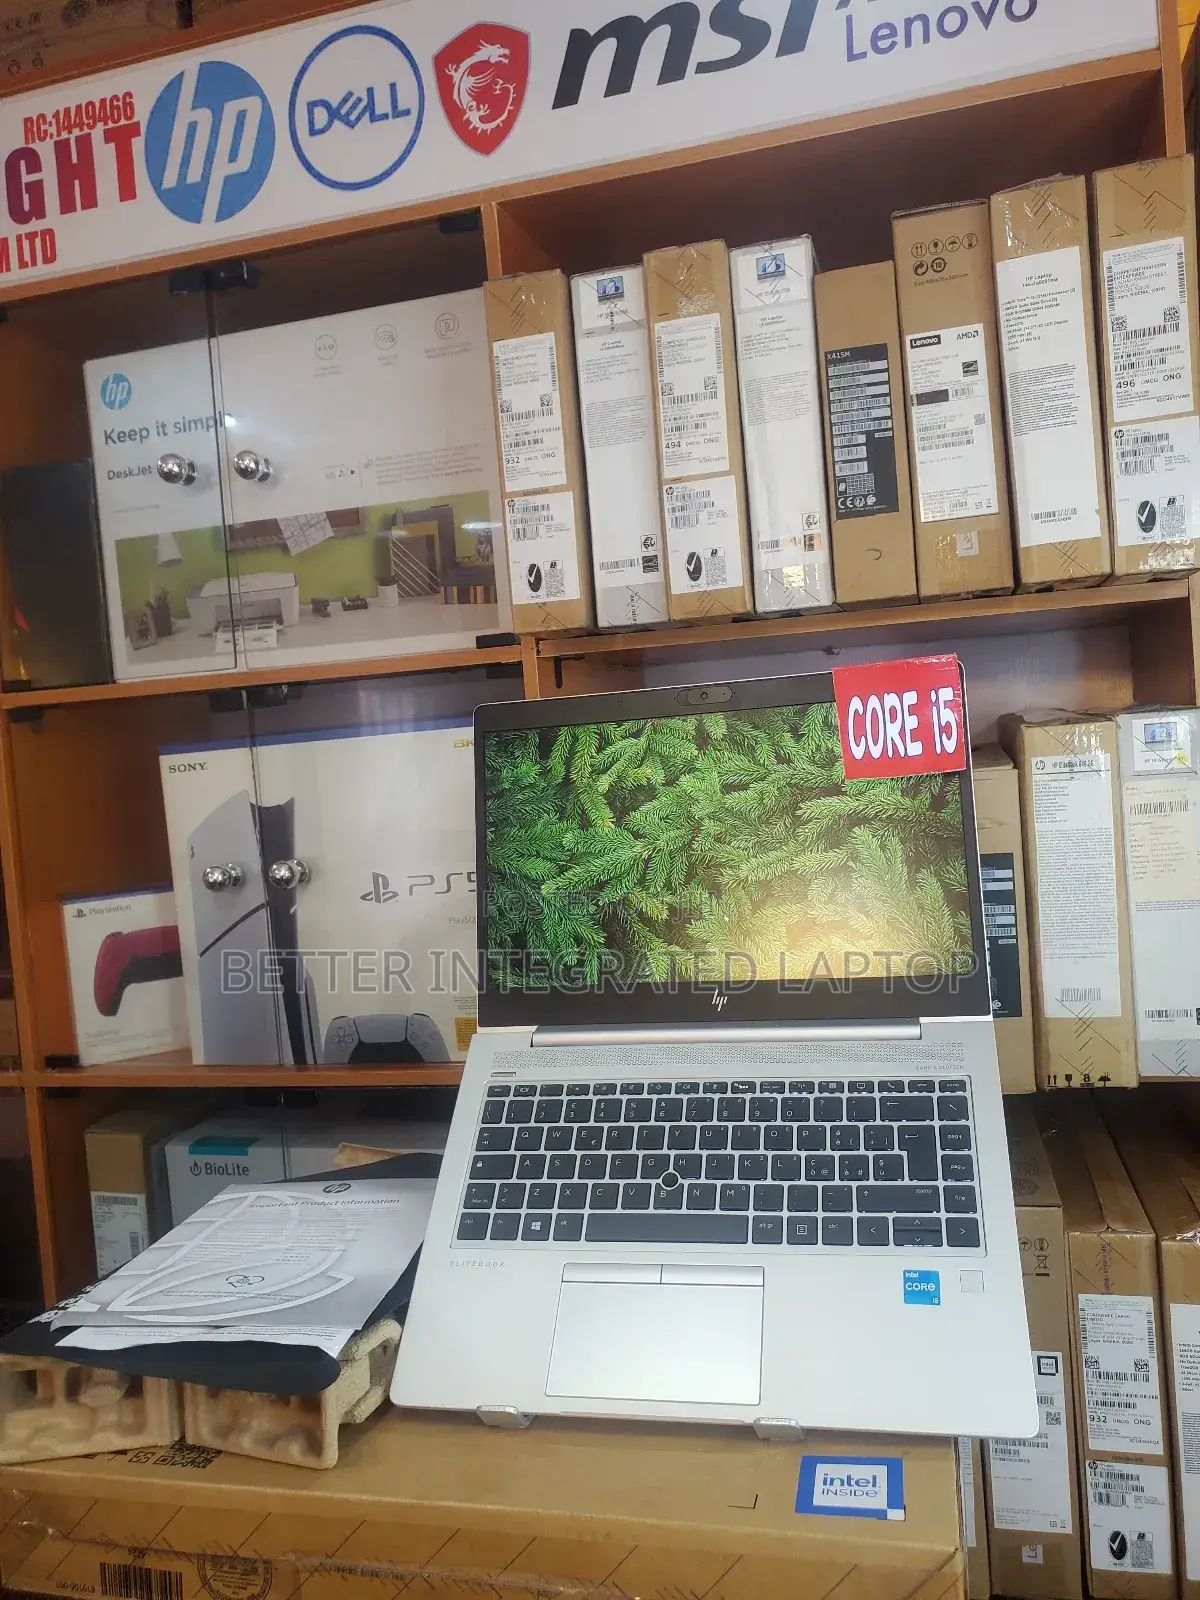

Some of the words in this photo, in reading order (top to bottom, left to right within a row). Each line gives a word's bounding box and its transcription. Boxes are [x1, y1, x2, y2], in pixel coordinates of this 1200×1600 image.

[846, 0, 1038, 62] Lenovo
[307, 82, 412, 138] DELL
[23, 92, 136, 145] RC:1449466
[150, 61, 274, 223] hp
[4, 121, 142, 225] GHT
[16, 228, 57, 270] LTD
[912, 337, 939, 347] Lenovo
[956, 331, 973, 340] AMD
[827, 351, 850, 360] X415M
[1115, 379, 1136, 389] 496
[1163, 372, 1182, 381] ONG
[102, 373, 132, 410] hp
[104, 425, 150, 445] Keep
[155, 419, 168, 437] it
[665, 441, 681, 449] 494
[505, 457, 520, 465] 932
[107, 465, 152, 481] DeskJet
[848, 690, 923, 760] CORE
[930, 686, 958, 755] i5
[168, 761, 208, 774] SONY
[88, 904, 132, 917] PlayStation
[204, 1162, 250, 1177] BioLite
[744, 1159, 751, 1167] K
[533, 1188, 540, 1196] Z
[564, 1188, 572, 1196] X
[596, 1188, 604, 1196] C
[628, 1188, 636, 1196] V
[726, 1189, 735, 1197] M
[249, 1201, 299, 1209] Important
[1089, 1415, 1107, 1424] 932
[1133, 1418, 1152, 1426] ONG
[822, 1473, 878, 1488] intel
